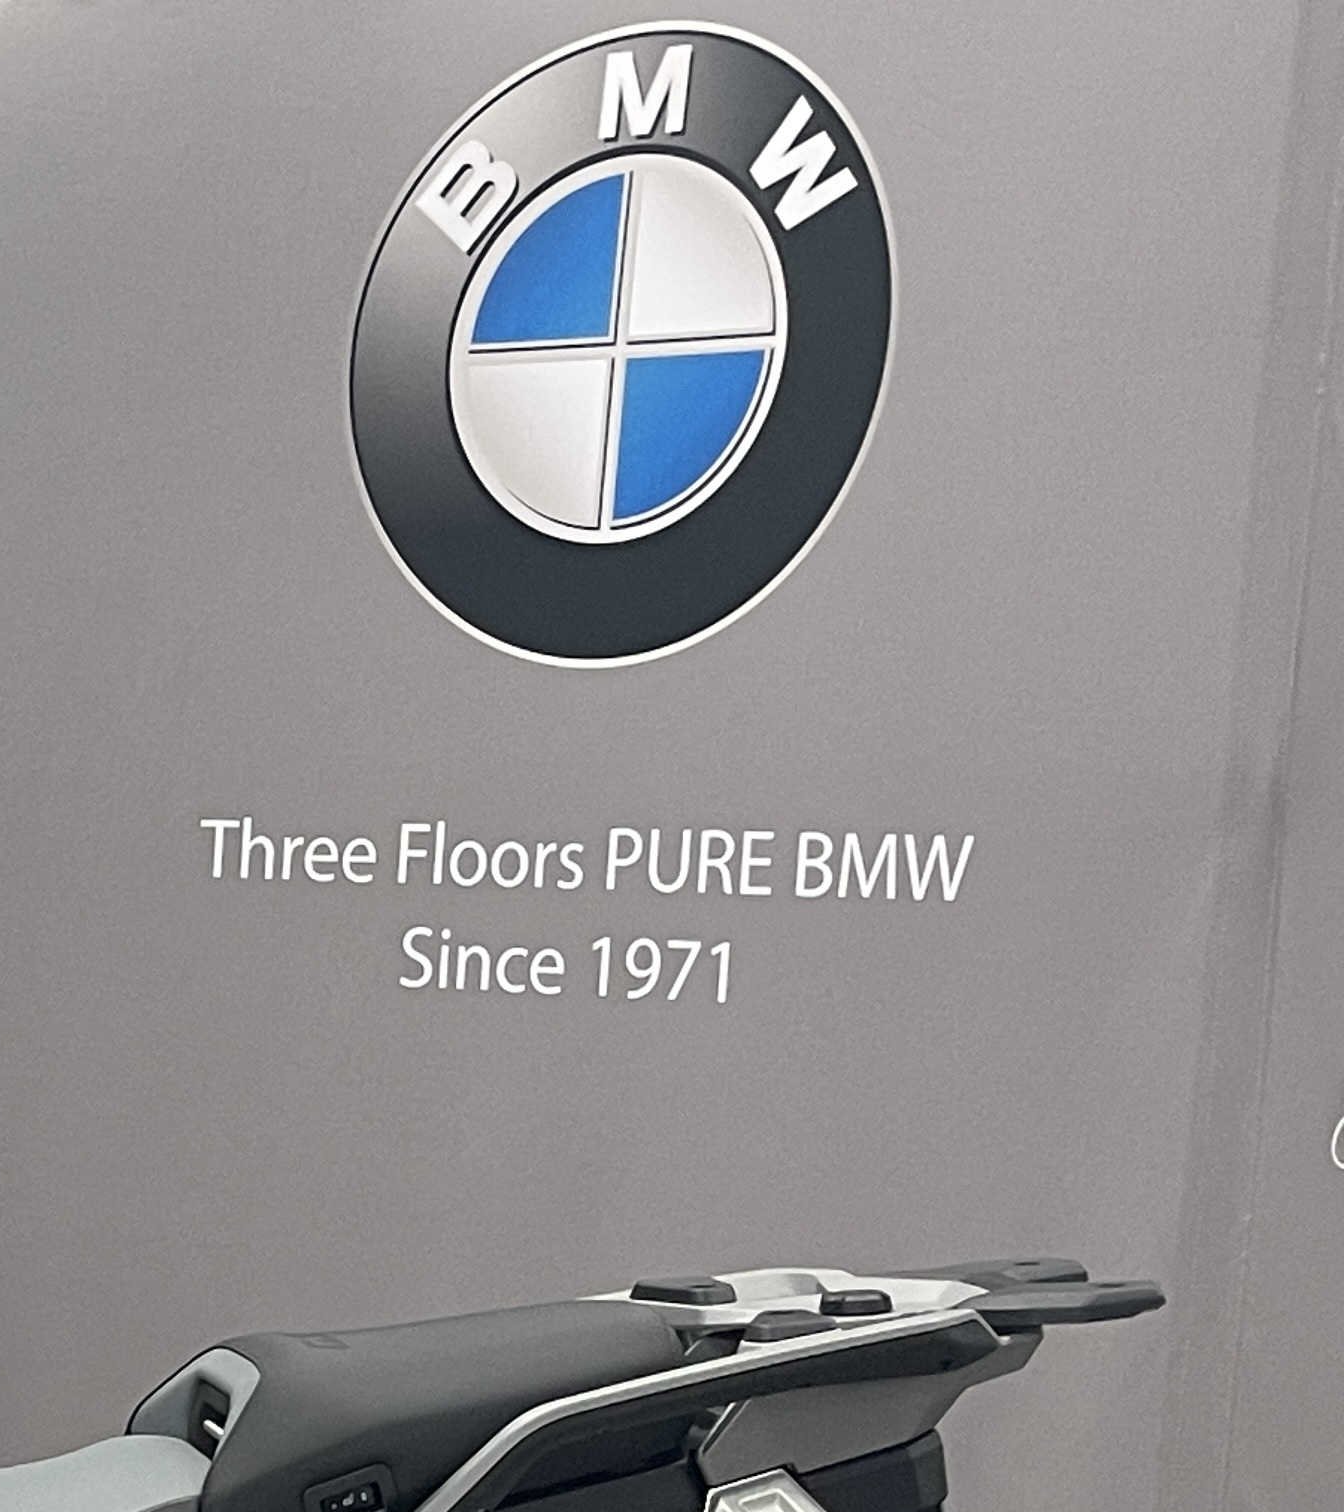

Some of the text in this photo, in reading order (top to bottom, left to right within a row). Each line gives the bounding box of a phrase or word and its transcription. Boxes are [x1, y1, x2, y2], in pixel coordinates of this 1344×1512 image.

[415, 43, 858, 255] BMW
[200, 816, 976, 901] Three Floors PURE BMW
[399, 926, 732, 1004] Since 1971
